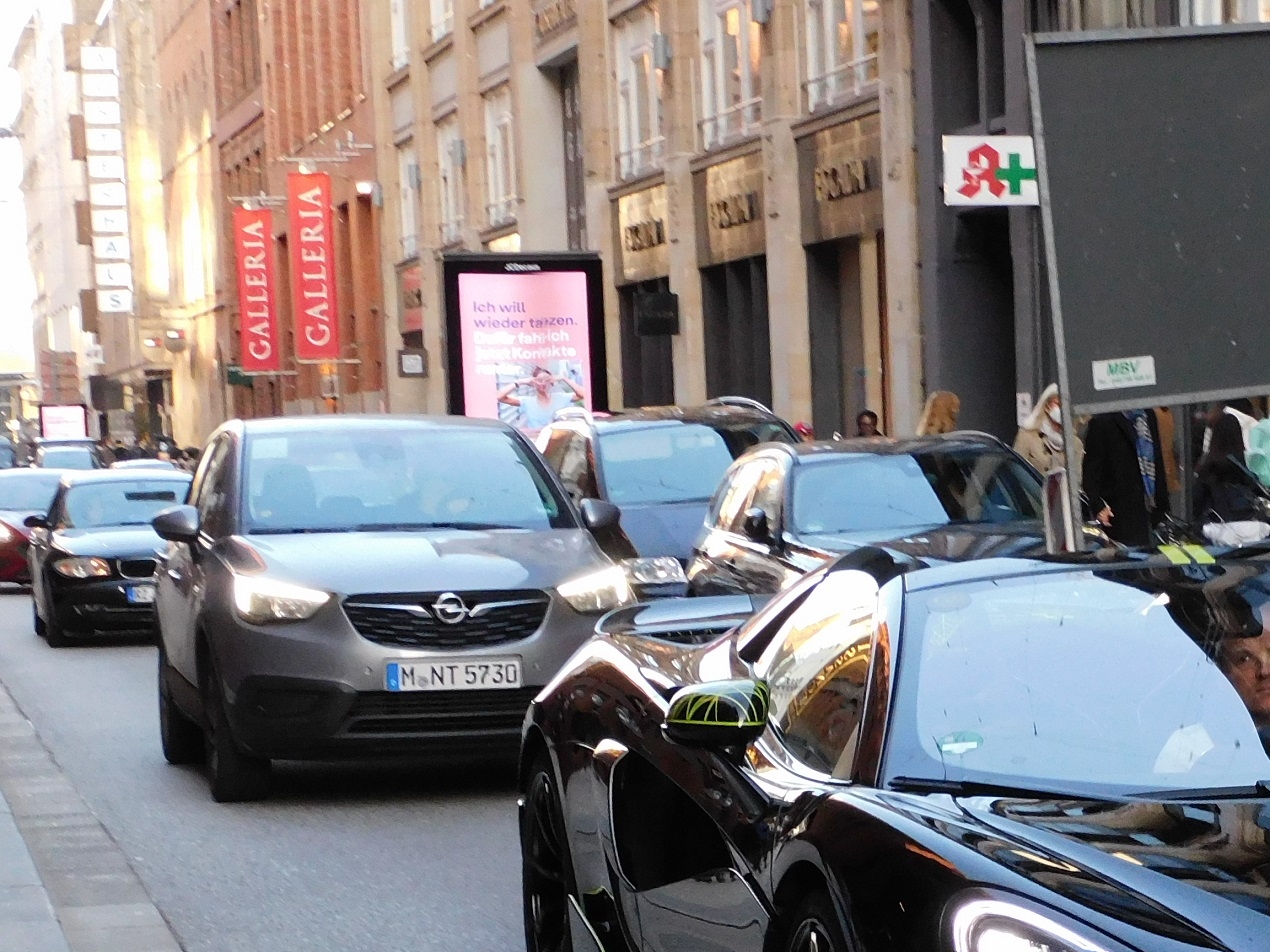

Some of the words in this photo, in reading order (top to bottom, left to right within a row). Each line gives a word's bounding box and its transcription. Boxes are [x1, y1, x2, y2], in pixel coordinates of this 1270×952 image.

[297, 185, 331, 347] GALLERIA
[241, 219, 272, 361] GALLERIA
[472, 301, 496, 313] Ich
[499, 301, 526, 313] will
[473, 316, 526, 328] wieder
[401, 666, 415, 686] M
[430, 665, 459, 685] NT
[464, 664, 518, 685] 5730
